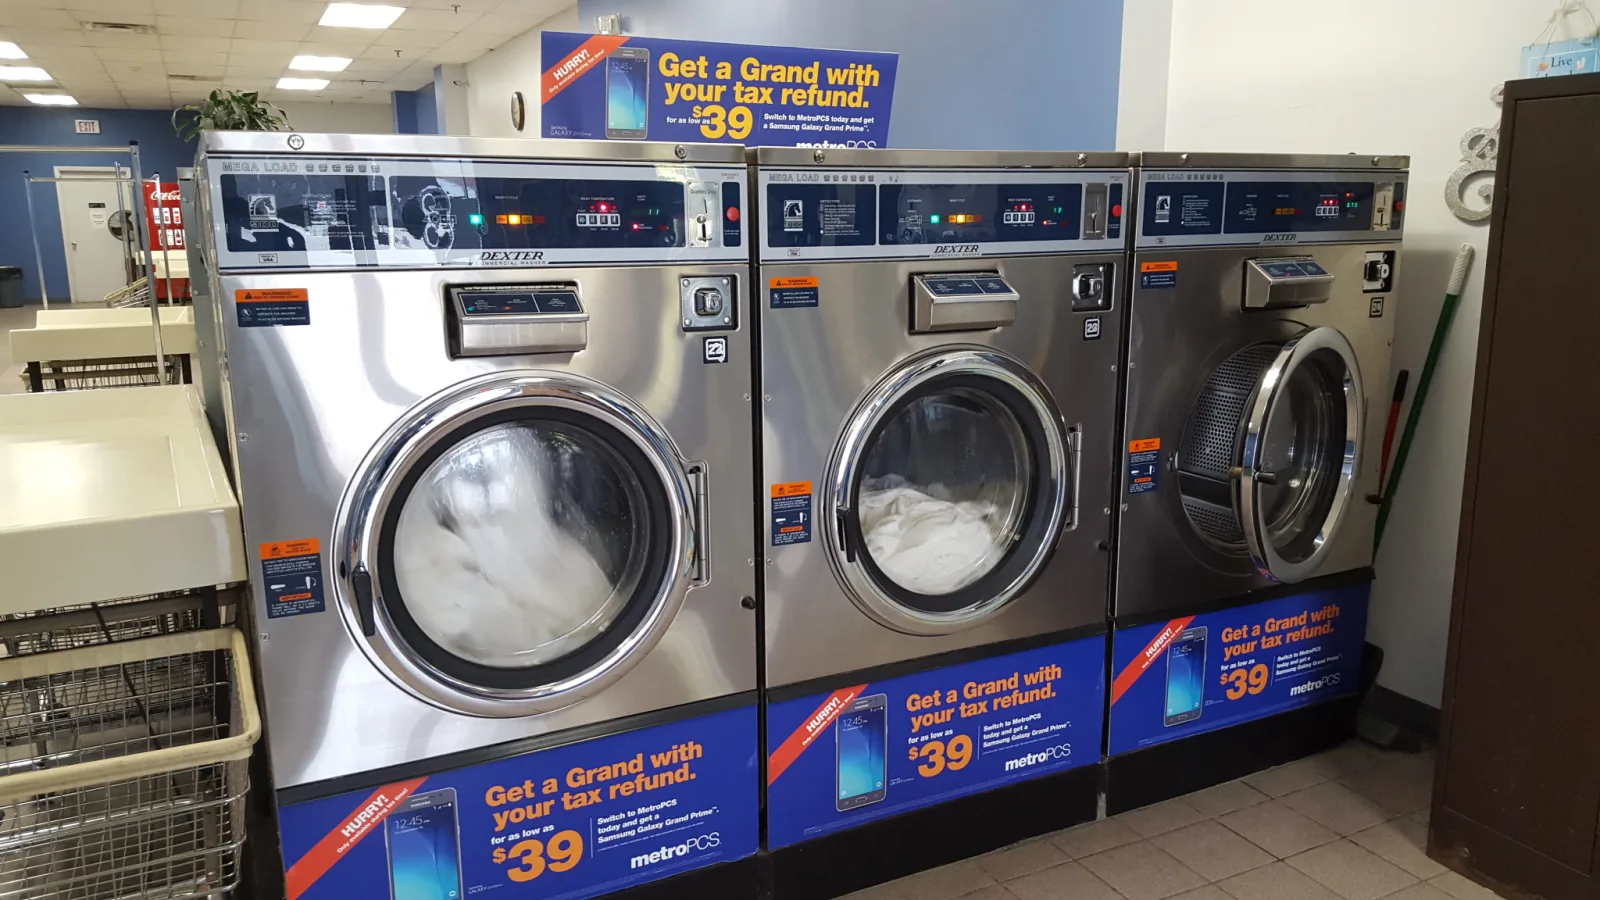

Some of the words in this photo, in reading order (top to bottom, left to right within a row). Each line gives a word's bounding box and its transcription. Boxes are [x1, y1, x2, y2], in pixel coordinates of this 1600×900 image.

[553, 49, 590, 80] HURRY!
[612, 62, 629, 70] 12:45
[658, 52, 708, 78] Get
[716, 62, 732, 80] a
[740, 60, 819, 84] Grand
[827, 62, 880, 86] with
[1551, 56, 1572, 68] Live
[664, 80, 726, 104] your
[734, 84, 773, 104] tax
[780, 86, 870, 108] refund.
[79, 122, 95, 132] EXIT
[666, 116, 677, 124] for
[688, 116, 700, 124] low
[693, 105, 754, 139] $39
[764, 113, 787, 121] Switch
[831, 116, 849, 124] today
[863, 117, 874, 125] get
[769, 122, 800, 131] Samsung
[801, 124, 823, 132] Galaxy
[222, 162, 260, 172] MEGA
[264, 162, 298, 172] LOAD
[769, 174, 794, 182] MEGA
[796, 174, 819, 182] LOAD
[480, 251, 544, 260] DEXTER
[933, 245, 979, 253] DEXTER
[1221, 625, 1248, 643] Get
[1251, 625, 1260, 636] a
[1265, 610, 1308, 633] Grand
[1310, 604, 1340, 622] with
[1145, 628, 1173, 657] HURRY!
[1224, 640, 1257, 661] your
[1261, 635, 1282, 649] tax
[1285, 622, 1334, 643] refund.
[1237, 660, 1247, 668] low
[1276, 661, 1289, 669] today
[1277, 654, 1293, 662] Switch
[1299, 646, 1321, 656] MetroPCS
[1276, 666, 1297, 676] Samsung
[1297, 662, 1312, 671] Galaxy
[1312, 659, 1326, 667] Grand
[906, 690, 942, 712] Get
[946, 689, 958, 703] a
[963, 672, 1019, 699] Grand
[1023, 663, 1062, 686] with
[1220, 663, 1268, 700] $39
[1290, 673, 1340, 696] metroPCS
[806, 696, 840, 732] HURRY!
[911, 708, 955, 733] your
[959, 701, 988, 718] tax
[993, 683, 1056, 710] refund.
[843, 716, 863, 727] 12:45
[983, 722, 1004, 732] Switch
[1012, 712, 1041, 725] MetroPCS
[983, 731, 1000, 740] today
[1001, 728, 1012, 736] and
[1013, 725, 1023, 734] get
[930, 730, 944, 740] low
[945, 729, 953, 737] as
[983, 737, 1011, 748] Samsung
[1011, 730, 1031, 741] Galaxy
[1032, 726, 1049, 736] Grand
[908, 734, 973, 778] $39
[1005, 743, 1071, 771] metroPCS
[485, 781, 535, 807] Get
[542, 777, 558, 795] a
[565, 753, 643, 789] Grand
[650, 740, 702, 768] with
[492, 798, 555, 832] your
[561, 787, 602, 811] tax
[609, 762, 696, 800] refund.
[337, 842, 350, 853] Only
[349, 823, 372, 843] available
[371, 808, 388, 823] during
[386, 800, 396, 808] tax
[394, 788, 408, 801] time!
[341, 794, 389, 837] HURRY!
[394, 816, 423, 830] 12:45
[597, 811, 625, 825] Switch
[627, 809, 636, 818] to
[637, 798, 678, 815] MetroPCS
[491, 835, 506, 846] for
[507, 832, 521, 842] as
[522, 827, 541, 839] low
[542, 823, 555, 834] as
[597, 823, 621, 834] today
[622, 818, 638, 828] and
[639, 815, 653, 825] get
[597, 829, 636, 844] Samsung
[637, 822, 664, 834] Galaxy
[665, 813, 689, 826] Grand
[492, 829, 584, 883] $39
[631, 831, 720, 869] metroPCS
